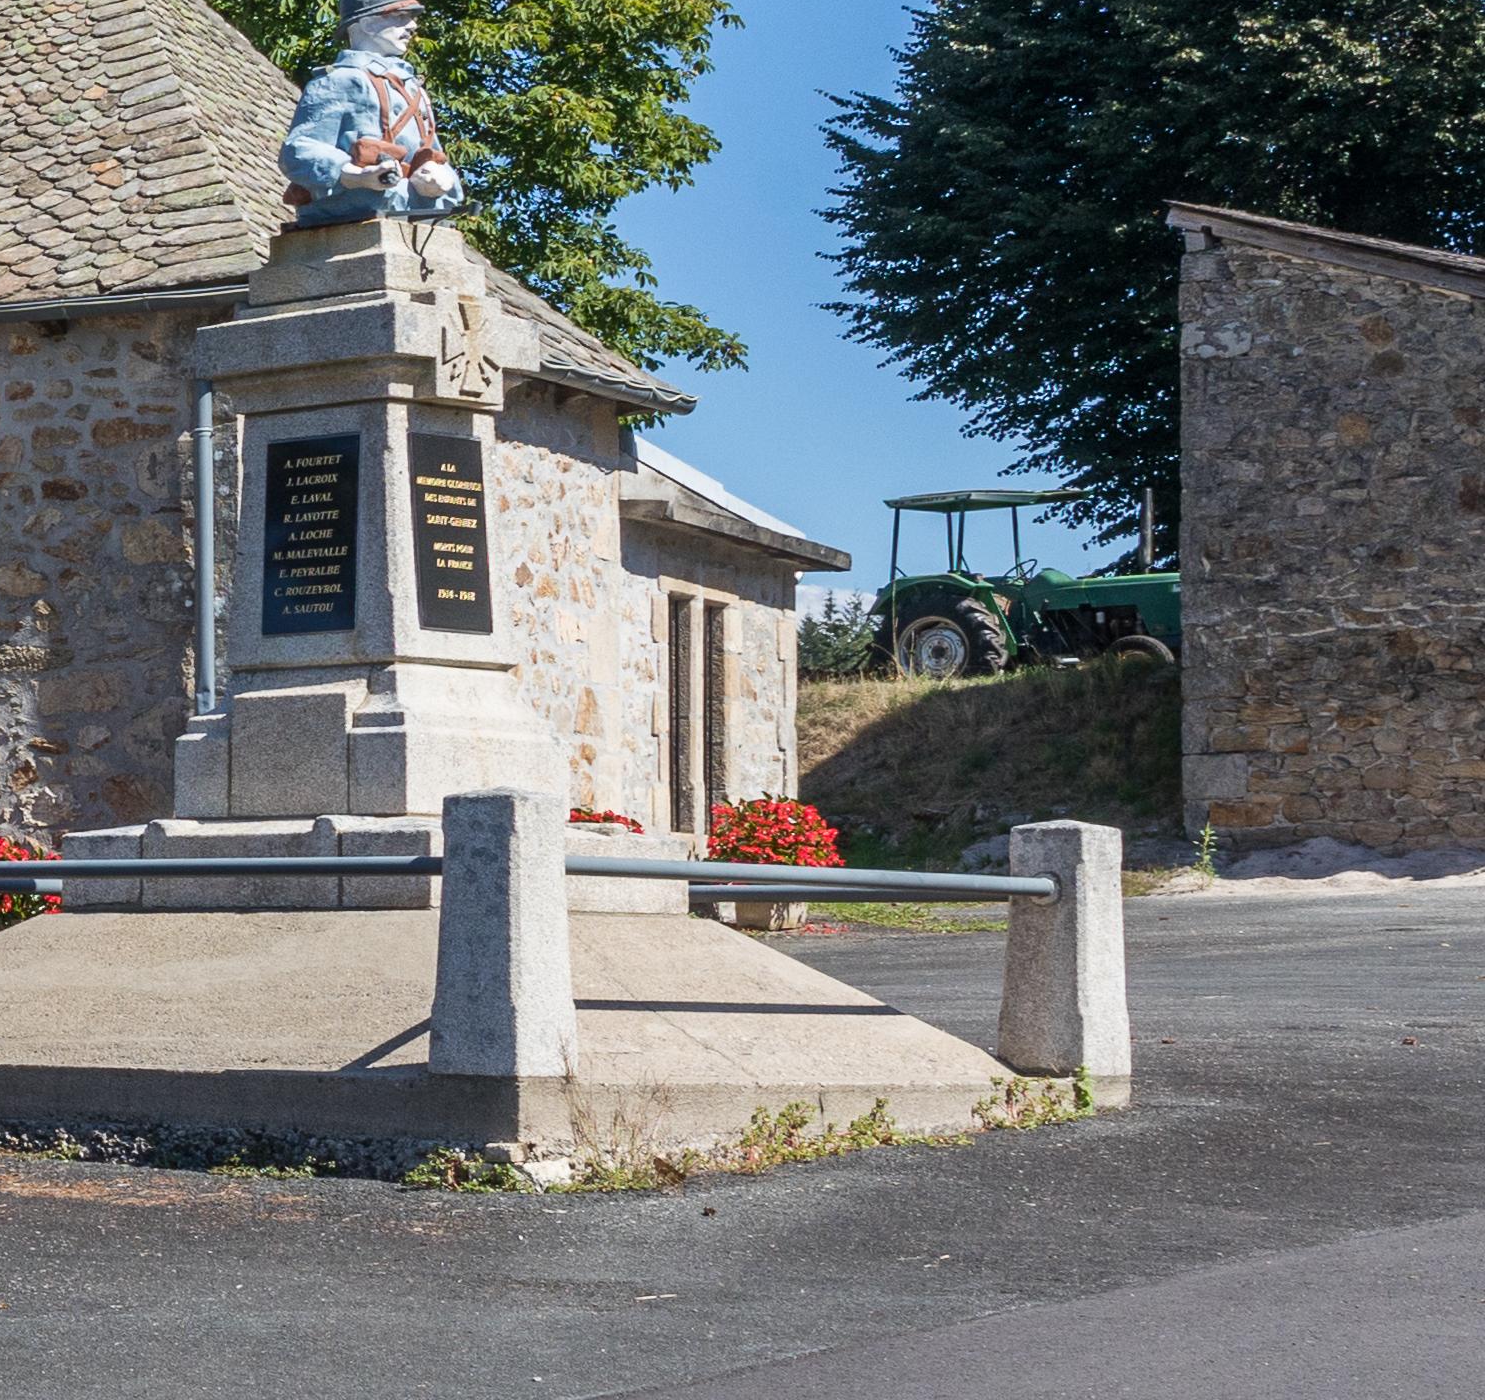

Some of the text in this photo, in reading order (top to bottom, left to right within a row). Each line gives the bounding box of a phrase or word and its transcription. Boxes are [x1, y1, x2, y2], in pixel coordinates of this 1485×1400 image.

[284, 454, 342, 468] A. FOURTET
[296, 473, 338, 486] LACROIX
[291, 492, 333, 504] E. LAVAL
[283, 510, 340, 523] R. LAYOTTE
[300, 529, 333, 540] LOCHE
[272, 546, 348, 560] M. MALEVIALLE
[436, 558, 446, 567] LA
[290, 565, 340, 577] PEYRALBE
[285, 584, 343, 596] ROUZEYROL
[294, 602, 334, 614] SAUTOU
